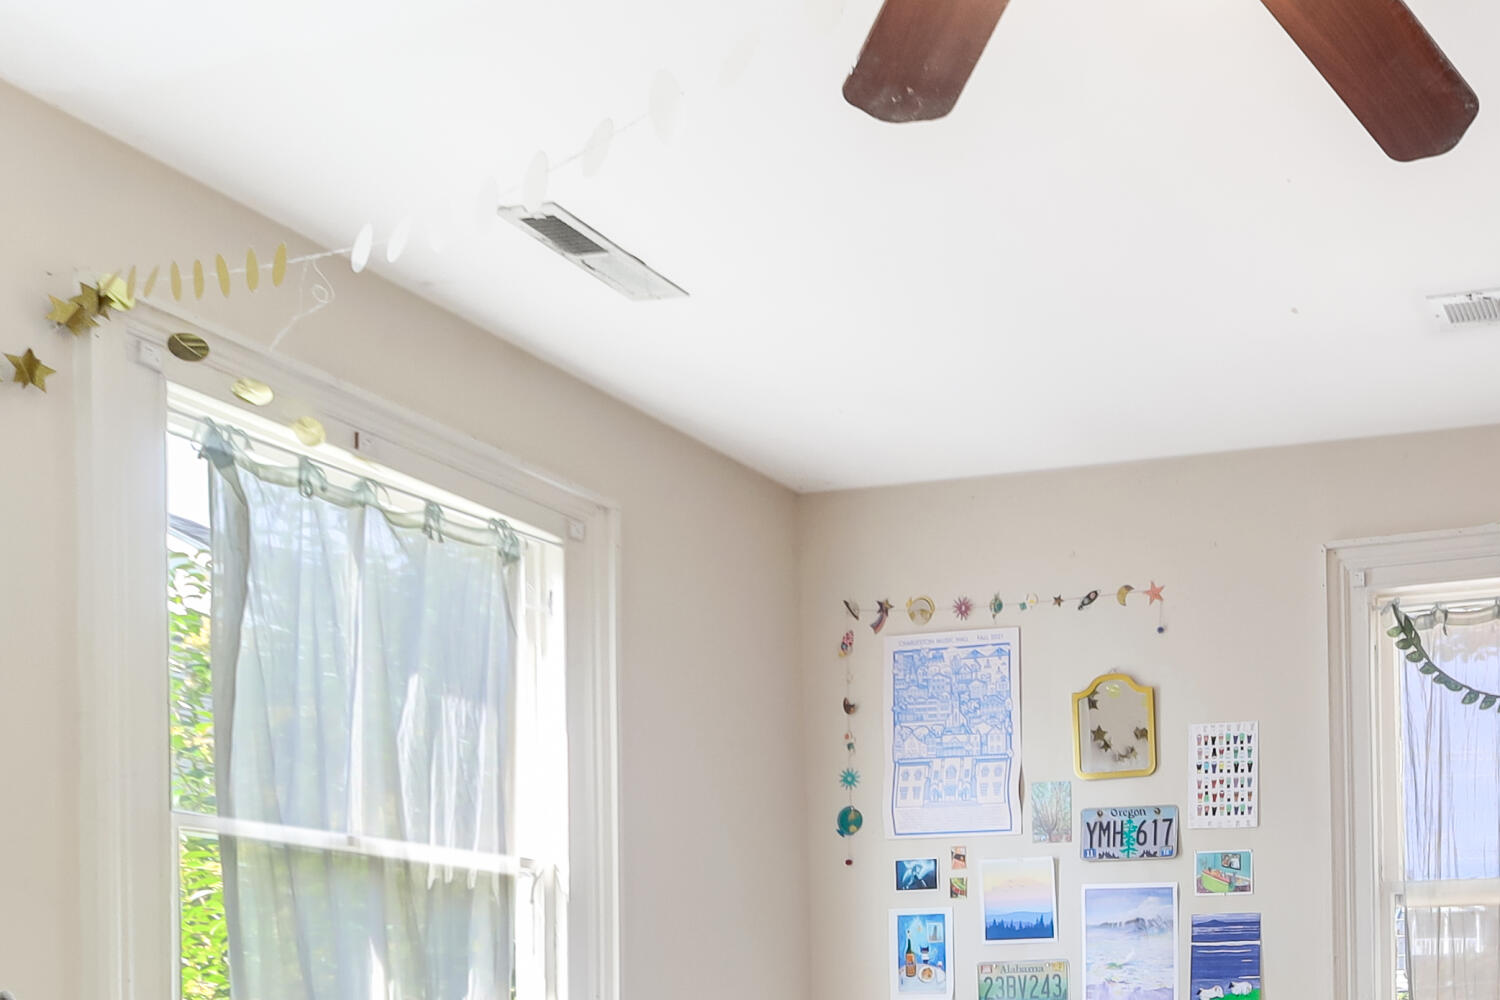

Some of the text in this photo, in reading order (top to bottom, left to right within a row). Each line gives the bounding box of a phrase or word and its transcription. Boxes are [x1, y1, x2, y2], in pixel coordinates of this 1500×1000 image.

[1110, 807, 1147, 818] Oregon
[1086, 818, 1173, 849] YMH 617
[1001, 963, 1044, 974] Alabama
[983, 973, 1062, 1000] 23BV243
